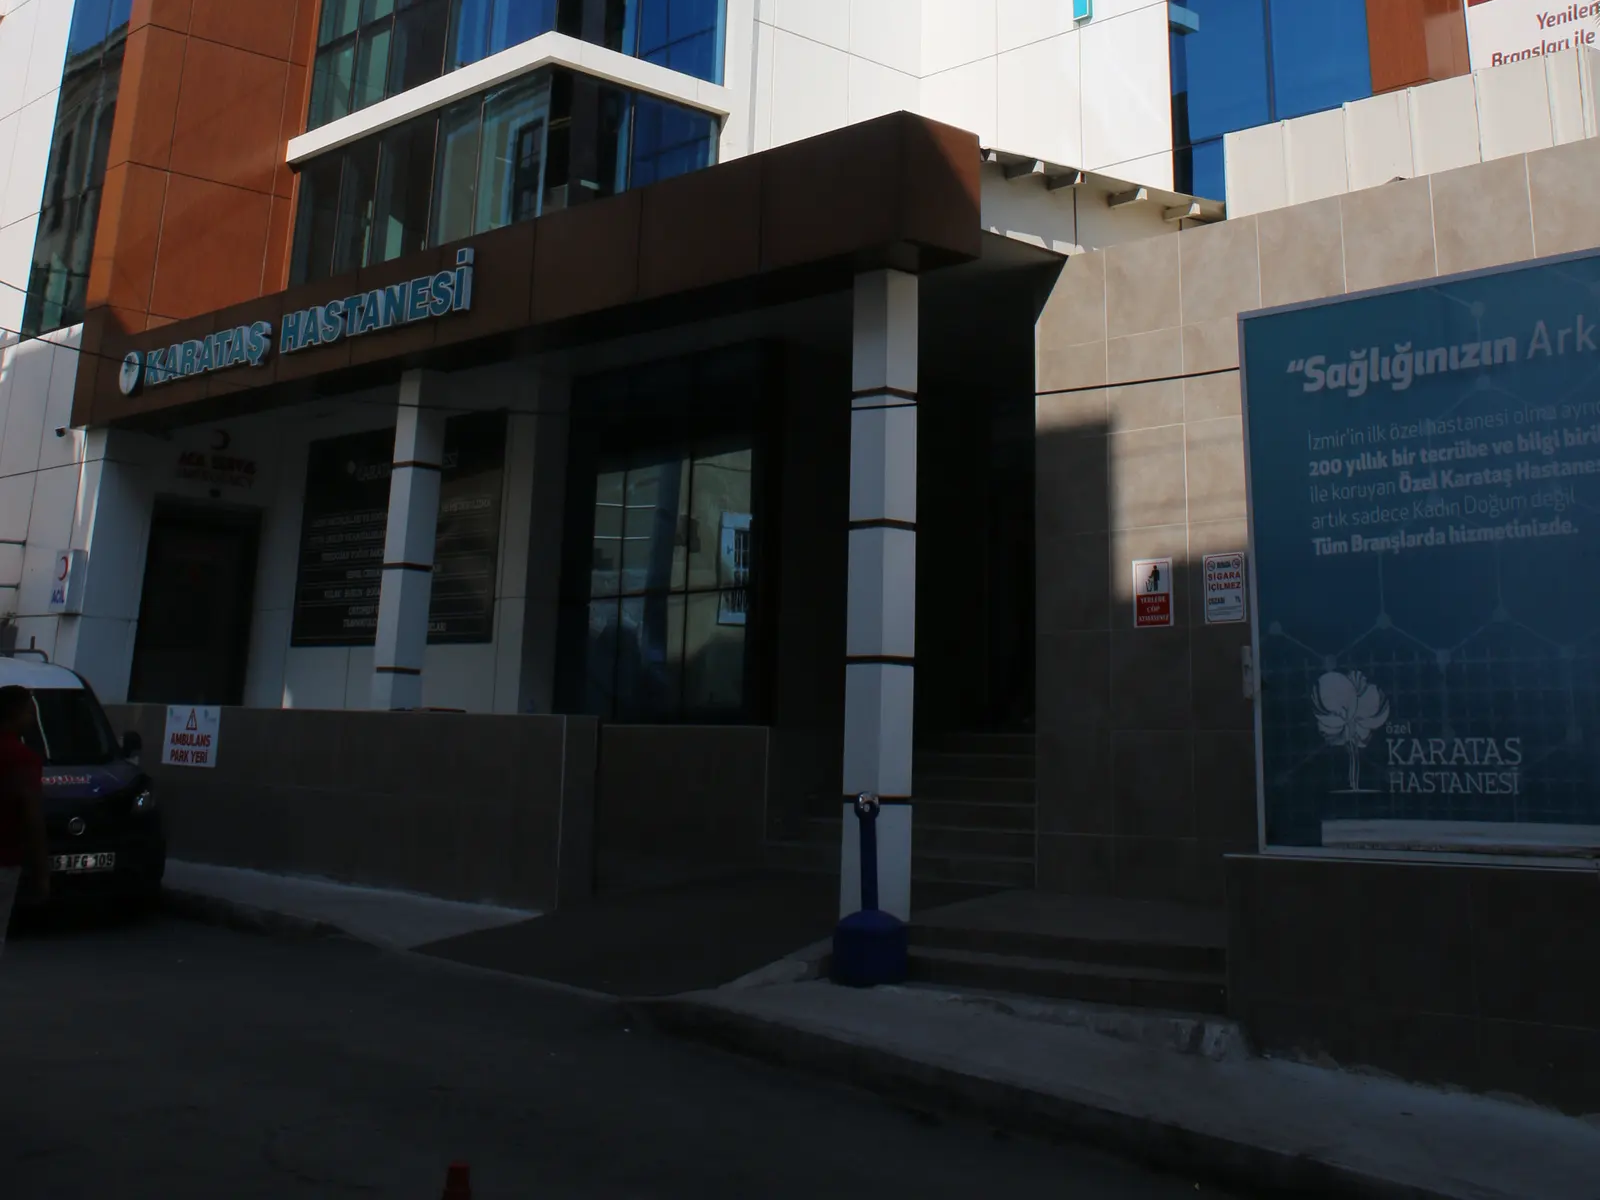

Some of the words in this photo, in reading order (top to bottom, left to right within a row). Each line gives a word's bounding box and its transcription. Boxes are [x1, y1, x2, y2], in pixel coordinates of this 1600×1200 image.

[1574, 29, 1595, 47] ile
[145, 320, 272, 386] KARATAŞ
[279, 247, 474, 355] HASTANESİ
[1526, 314, 1598, 360] Ark
[1367, 424, 1387, 443] ilk
[1389, 419, 1423, 441] özel
[1425, 408, 1509, 437] hastanesi
[1513, 404, 1557, 425] olma
[1309, 458, 1342, 476] 200
[1345, 450, 1389, 478] yıllık
[1391, 446, 1416, 467] bir
[1420, 437, 1489, 465] tecrübe
[1492, 439, 1514, 455] ve
[1516, 429, 1560, 456] bilgi
[1310, 484, 1329, 504] ile
[1331, 480, 1396, 503] koruyan
[1399, 468, 1438, 494] Özel
[1440, 467, 1513, 490] Karataş
[1311, 507, 1349, 530] artık
[1351, 505, 1409, 526] sadece
[1412, 497, 1461, 519] Kadın
[1464, 492, 1528, 519] Doğum
[1530, 484, 1576, 513] değil
[1311, 536, 1349, 556] Tüm
[1350, 526, 1446, 555] Branşlarda
[1448, 516, 1579, 545] hizmetinizde.
[170, 732, 211, 747] AMBULANS
[1385, 721, 1412, 735] özel
[170, 749, 189, 763] PARK
